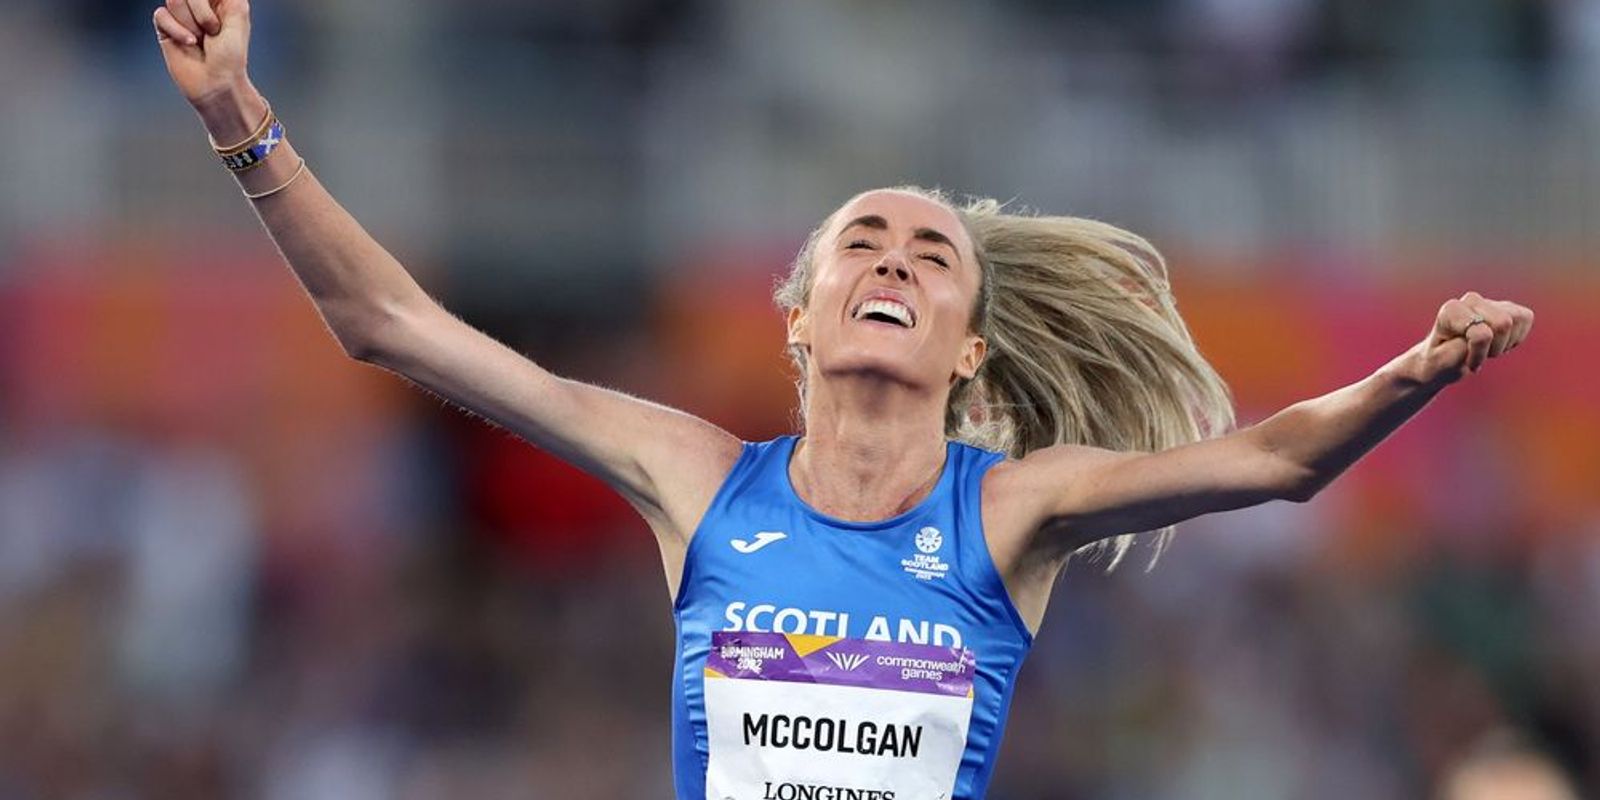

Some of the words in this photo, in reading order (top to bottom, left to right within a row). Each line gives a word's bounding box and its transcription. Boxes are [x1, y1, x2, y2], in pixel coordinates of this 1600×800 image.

[721, 646, 784, 660] BIRMINGHAM
[901, 668, 943, 681] games
[743, 713, 922, 757] MCCOLGAN
[763, 782, 896, 800] LONGINES
